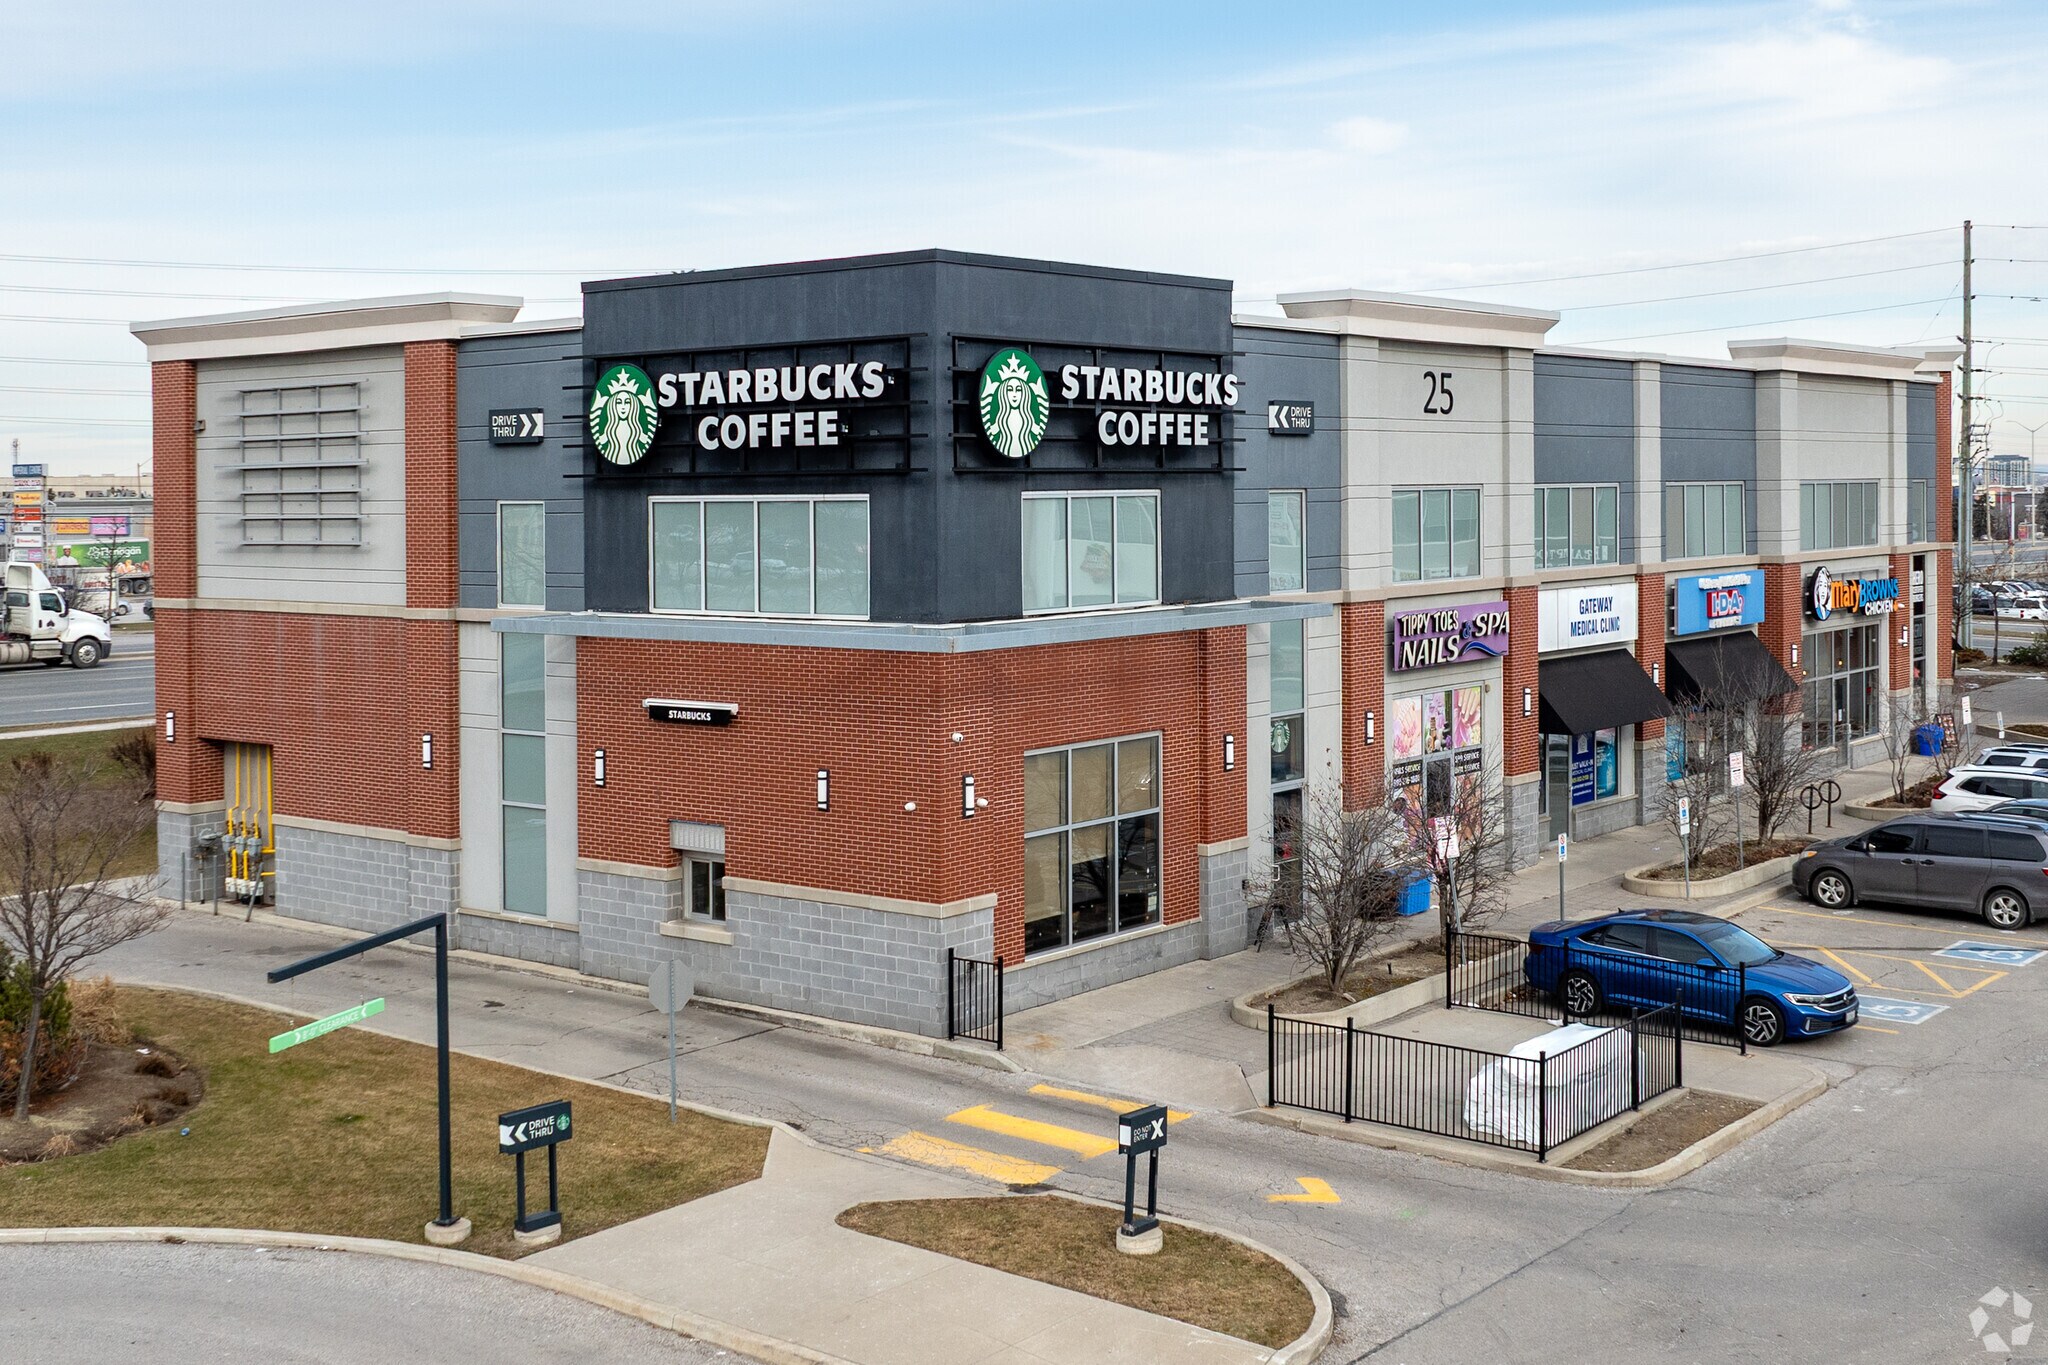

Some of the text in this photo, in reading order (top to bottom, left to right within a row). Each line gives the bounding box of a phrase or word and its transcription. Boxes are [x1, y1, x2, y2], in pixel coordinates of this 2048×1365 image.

[658, 361, 886, 407] STARBUCKS
[1061, 364, 1239, 406] STARBUCKS
[1423, 371, 1454, 415] 25
[492, 415, 517, 426] DRIVE
[1291, 406, 1311, 418] DRIVE
[492, 427, 516, 437] THRU
[698, 411, 839, 450] COFFEE
[1098, 411, 1209, 446] COFFEE
[1291, 418, 1310, 428] THRU
[1579, 596, 1613, 615] GATEWAY
[1865, 599, 1894, 616] CHICKEN
[1401, 609, 1459, 637] TIPPY TOES
[1462, 611, 1510, 639] & SPA
[1570, 616, 1620, 637] MEDICAL CLINIC
[1402, 634, 1460, 668] NAILS
[668, 710, 711, 721] STARBUCKS
[528, 1115, 555, 1131] DRIVE
[1133, 1124, 1151, 1136] DO NOT
[529, 1126, 554, 1140] THRU
[1133, 1132, 1148, 1143] ENTER
